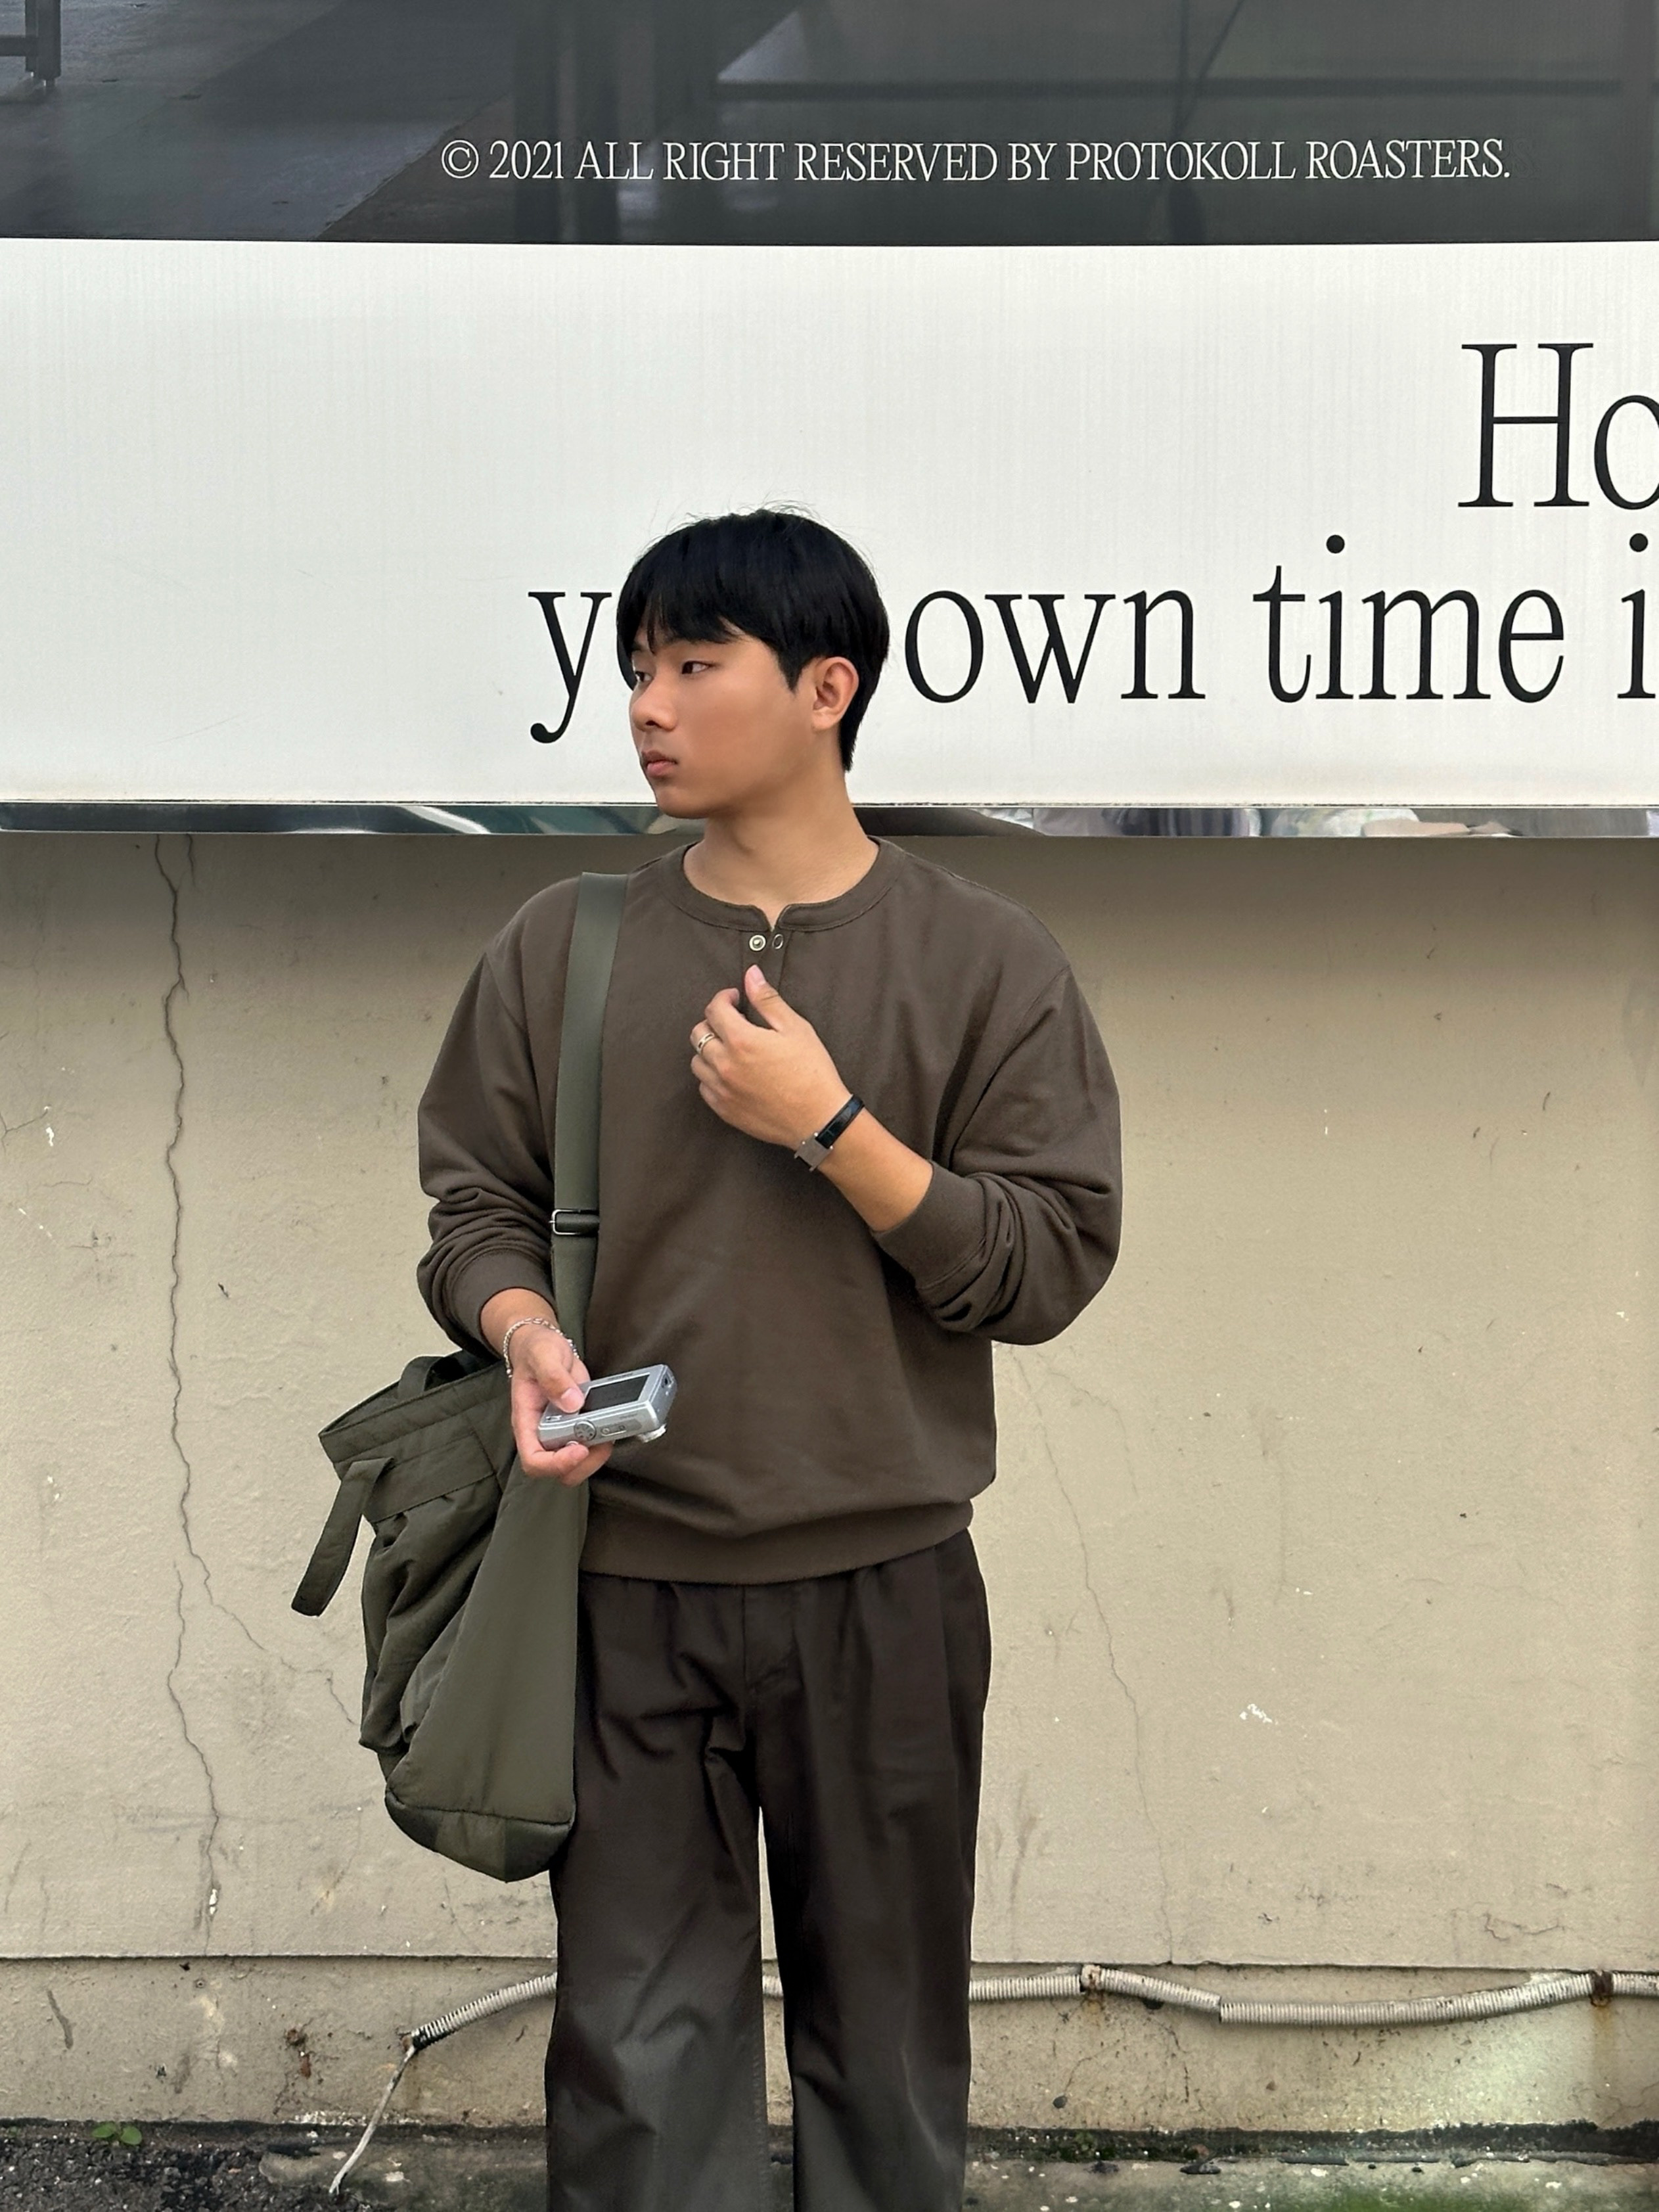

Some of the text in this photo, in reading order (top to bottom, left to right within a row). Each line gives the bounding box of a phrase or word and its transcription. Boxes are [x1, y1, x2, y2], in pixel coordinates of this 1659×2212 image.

[489, 140, 564, 179] 2021
[574, 141, 654, 179] ALL
[662, 142, 784, 180] RIGHT
[794, 143, 997, 181] RESERVED
[1007, 143, 1057, 180] BY
[1066, 141, 1296, 180] PROTOKOLL
[1305, 138, 1511, 179] ROASTERS.
[1458, 342, 1659, 509] Ho
[905, 590, 1205, 703] own
[1253, 534, 1563, 703] time
